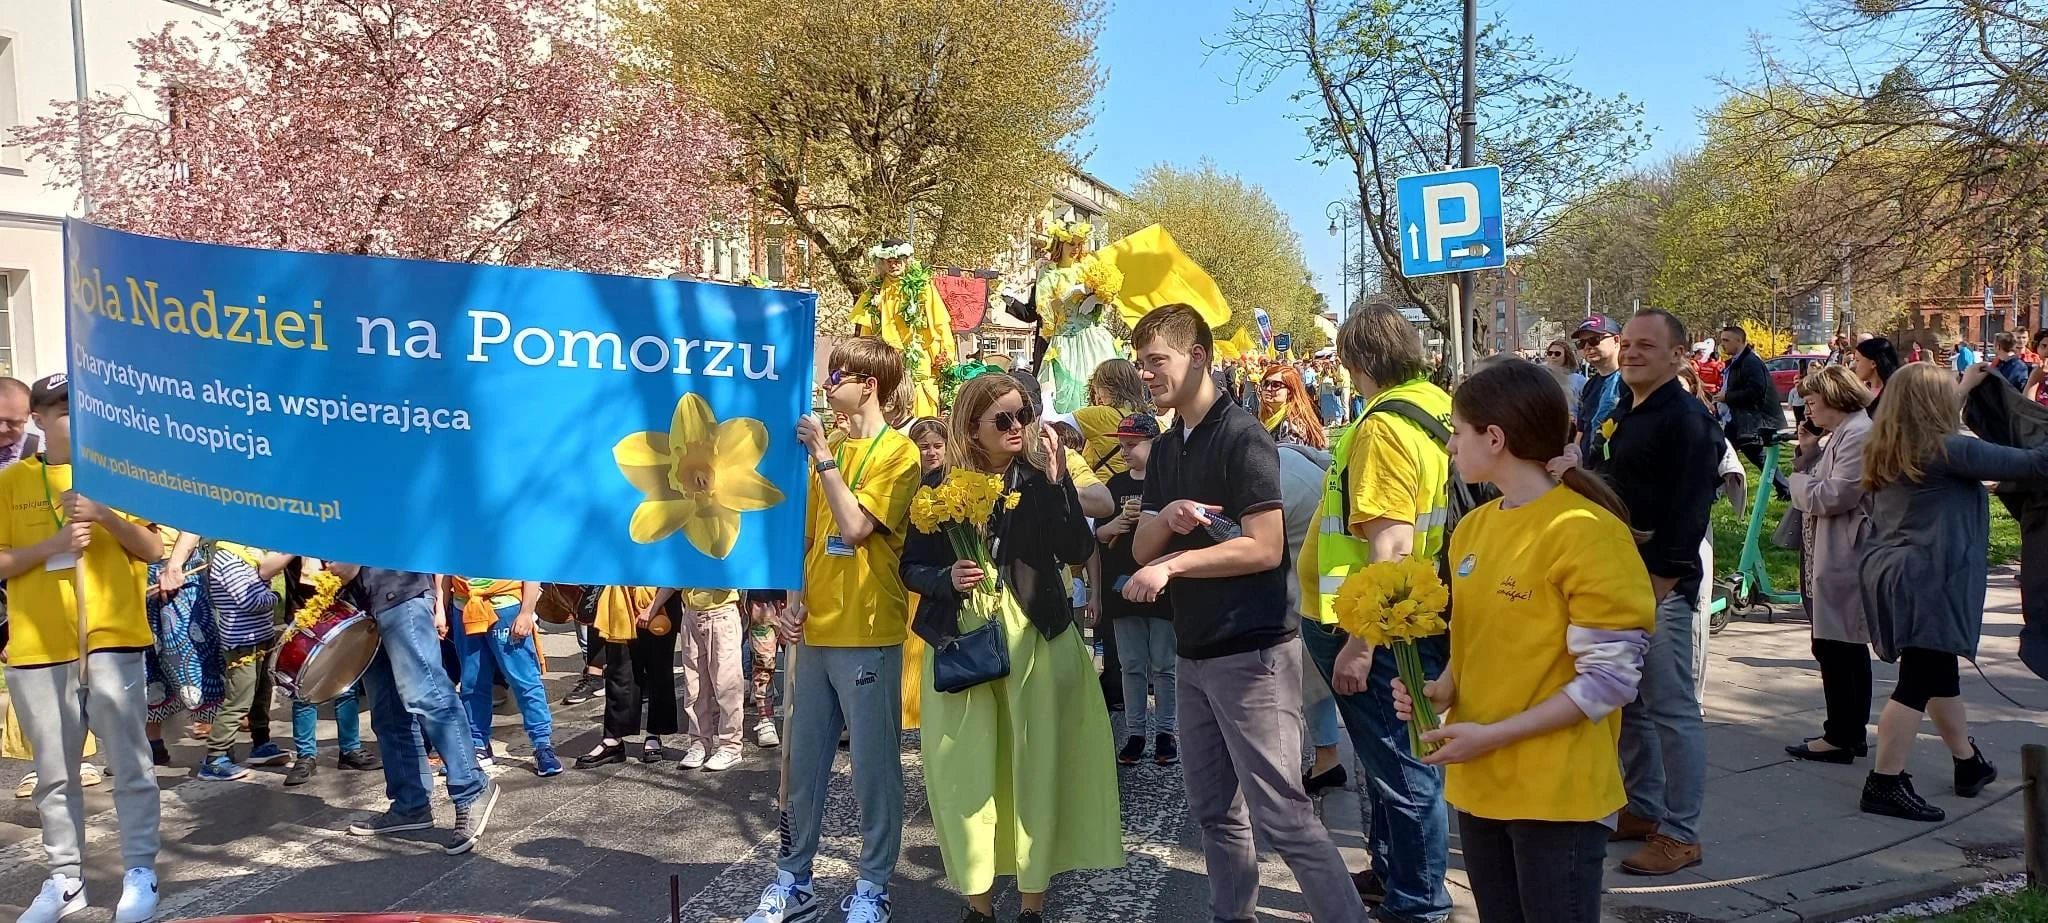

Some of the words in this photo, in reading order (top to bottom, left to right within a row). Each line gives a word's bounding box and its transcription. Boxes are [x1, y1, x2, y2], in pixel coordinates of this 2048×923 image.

[1423, 182, 1481, 262] P
[69, 259, 125, 322] Pola
[126, 276, 329, 352] Nadziei
[356, 313, 441, 360] na
[466, 309, 780, 381] Pomorzu
[50, 374, 67, 384] NIK
[75, 342, 196, 401] Charytatywna
[202, 378, 272, 416] akcja
[279, 393, 471, 434] wspierająca
[76, 387, 161, 435] pomorskie
[165, 416, 272, 460] hospicja
[80, 444, 342, 522] www.polanadzieinapomorzu.pl
[855, 676, 876, 687] PUMA
